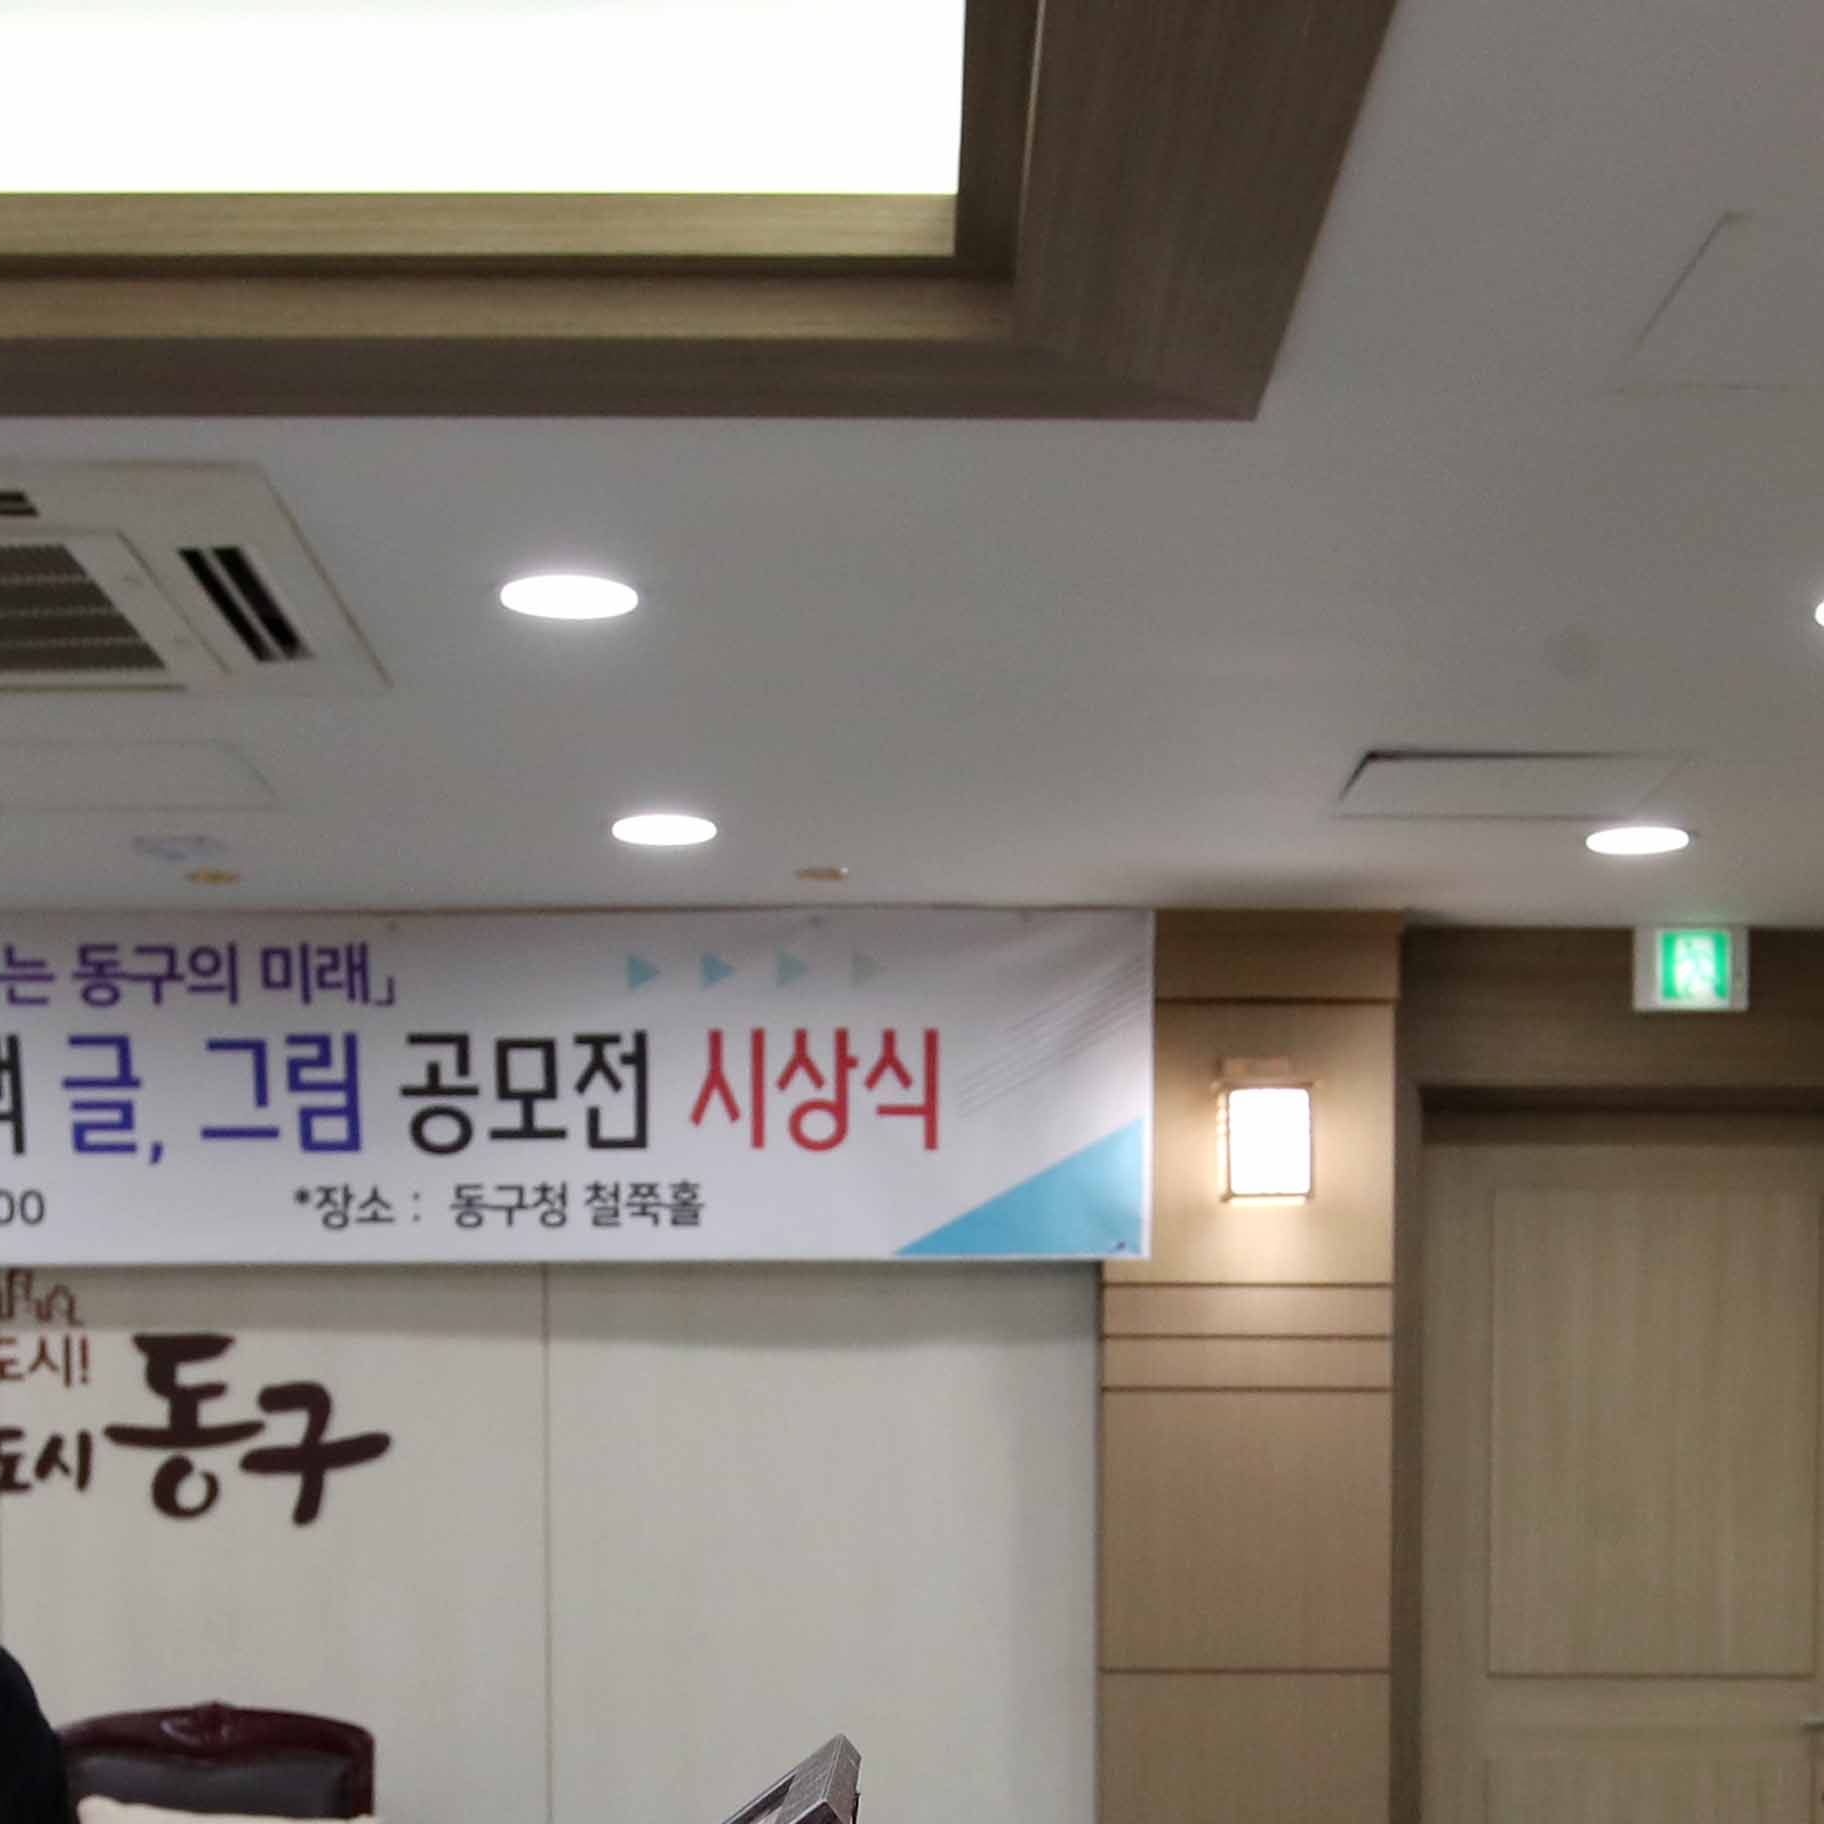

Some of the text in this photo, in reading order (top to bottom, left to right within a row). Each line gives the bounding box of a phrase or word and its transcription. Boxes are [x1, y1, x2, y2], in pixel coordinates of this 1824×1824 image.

[71, 941, 239, 1006] 동구의
[61, 1033, 164, 1164] 글,
[200, 1031, 363, 1154] 그림
[399, 1029, 649, 1155] 공모전
[690, 1026, 940, 1152] 시상식
[450, 1182, 569, 1229] 동구청
[584, 1181, 705, 1228] 철쭉홀
[103, 1331, 392, 1527] 동구
